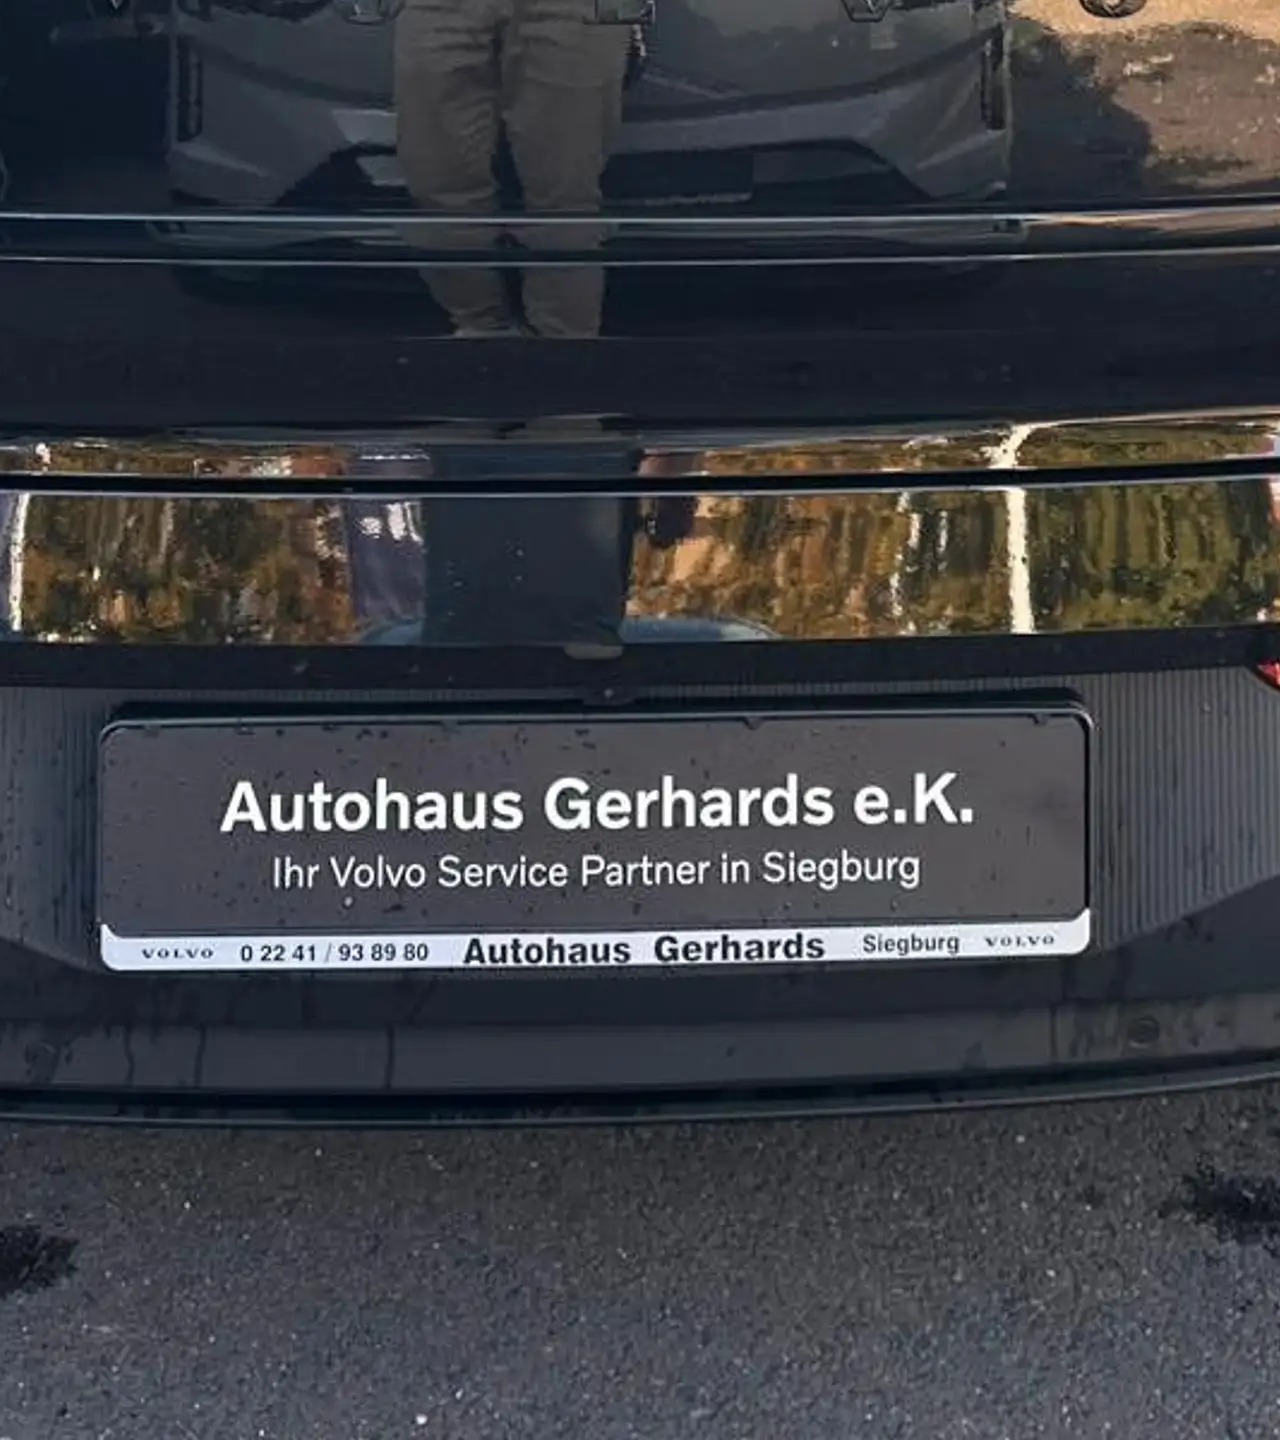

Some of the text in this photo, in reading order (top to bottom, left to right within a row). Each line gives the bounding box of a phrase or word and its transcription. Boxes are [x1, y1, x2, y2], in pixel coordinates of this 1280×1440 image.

[220, 771, 974, 832] Autohaus Gerhards e.K.
[272, 849, 921, 890] Ihr Volvo Service Partner in Siegburg
[141, 948, 215, 960] VOLVO
[239, 945, 253, 962] 0
[260, 944, 285, 962] 22
[292, 944, 317, 962] 41
[338, 943, 365, 962] 93
[371, 942, 398, 962] 89
[403, 942, 430, 962] 80
[462, 937, 631, 966] Autohaus
[653, 932, 826, 962] Gerhards
[862, 934, 961, 956] Siegburg
[984, 935, 1057, 949] VOLVO
